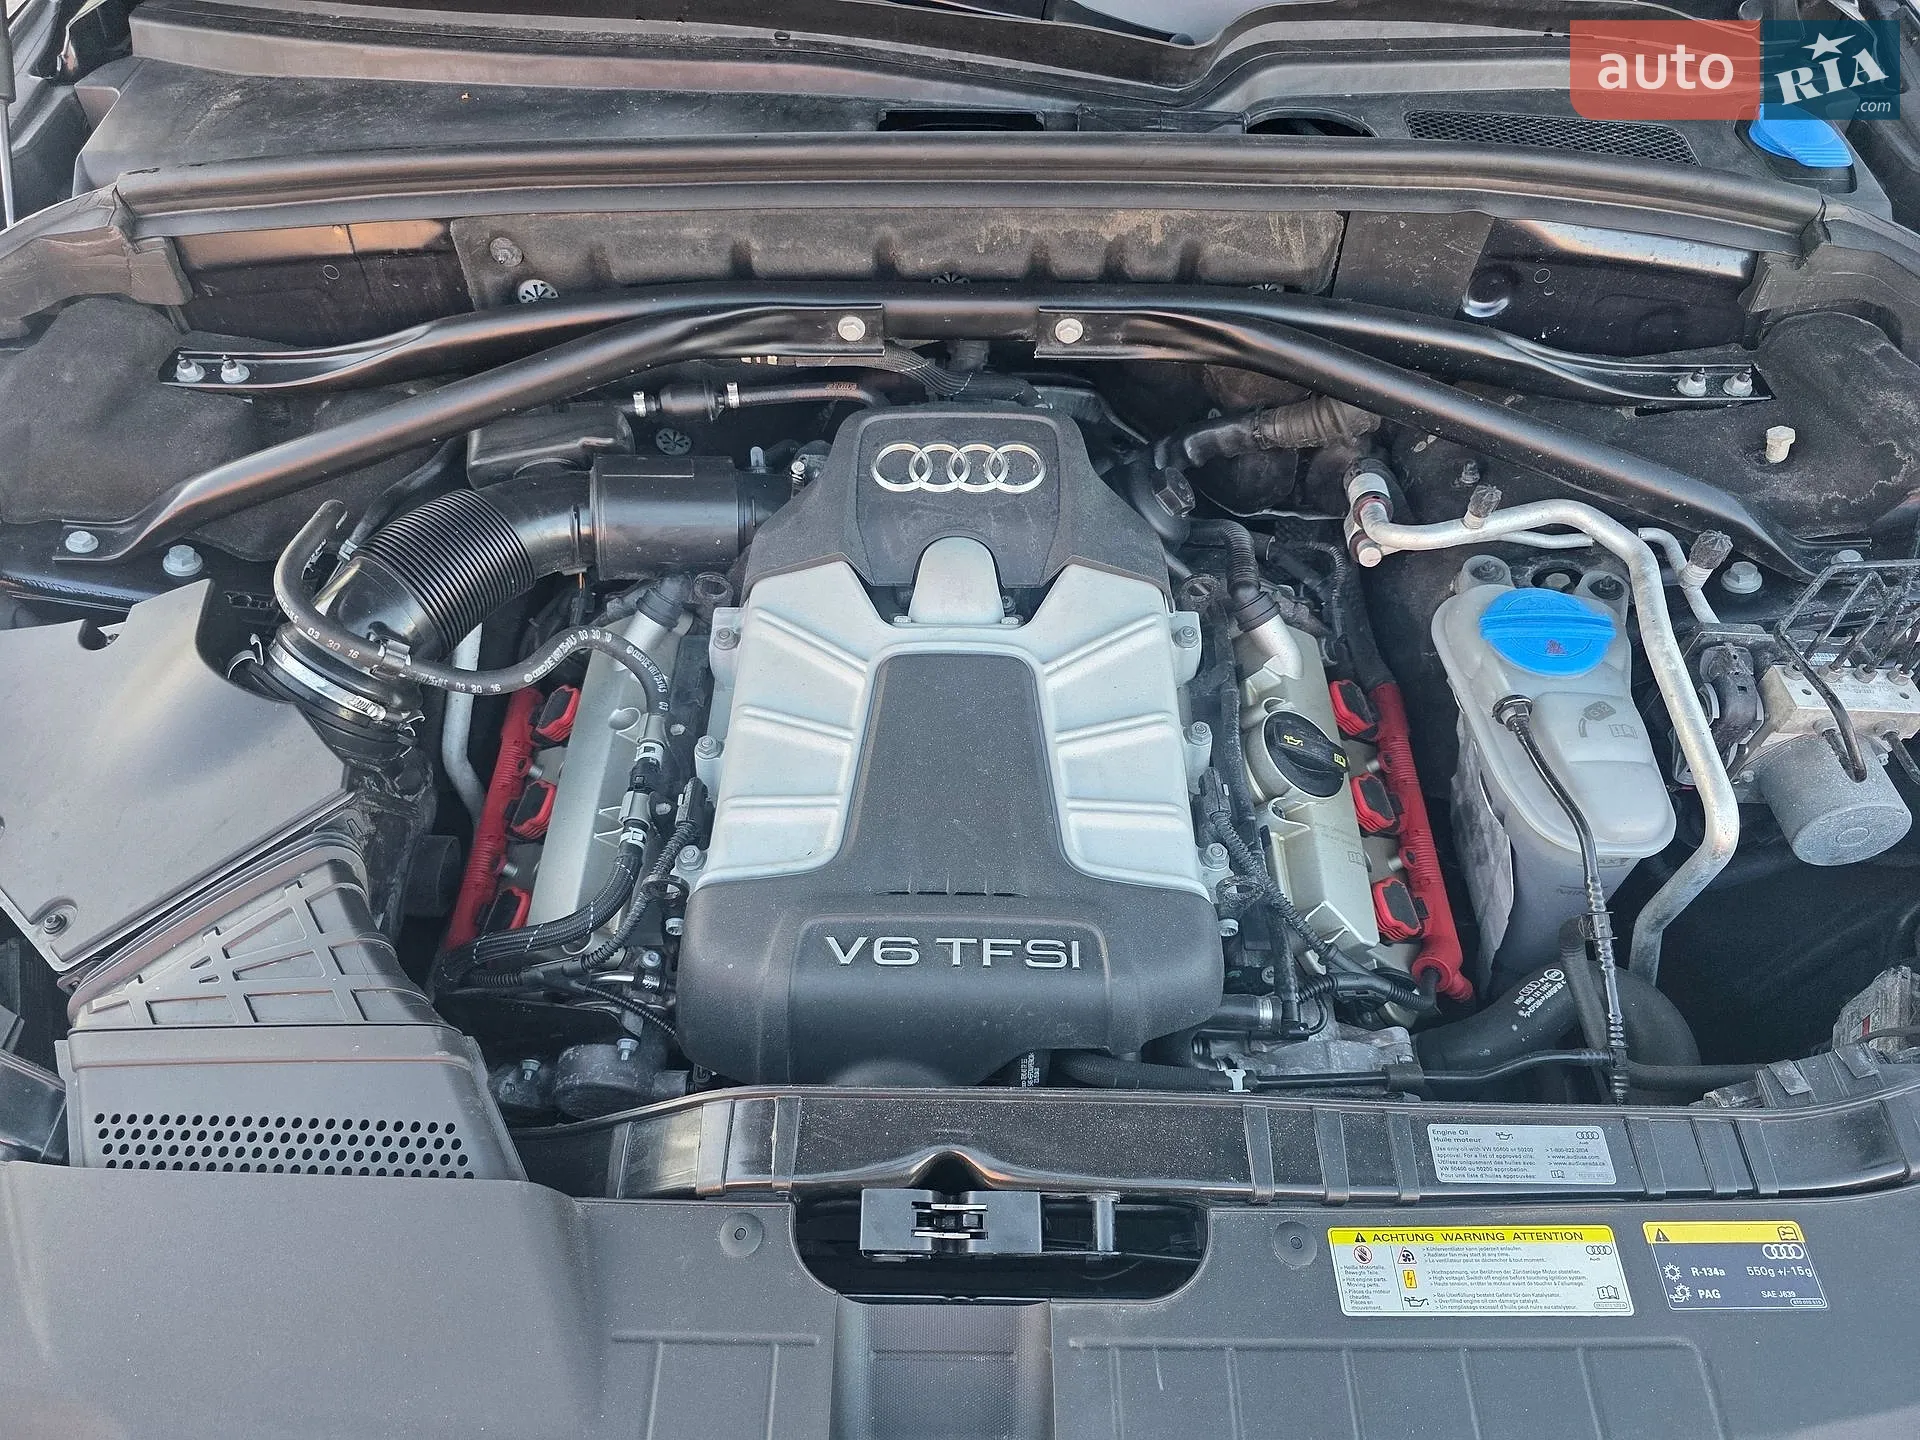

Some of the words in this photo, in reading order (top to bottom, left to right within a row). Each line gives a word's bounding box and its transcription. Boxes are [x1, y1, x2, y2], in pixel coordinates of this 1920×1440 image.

[307, 627, 321, 640] 03
[327, 639, 341, 651] 30
[347, 648, 360, 659] 16
[470, 684, 482, 693] 30
[490, 683, 502, 692] 16
[825, 936, 920, 966] V6
[936, 938, 1081, 970] TFSI
[1372, 1232, 1434, 1242] ACHTUNG
[1441, 1232, 1505, 1241] WARNING
[1512, 1231, 1583, 1241] ATTENTION
[1691, 1266, 1726, 1277] R-134a
[1746, 1266, 1775, 1278] 550g
[1698, 1289, 1721, 1299] PAG
[1761, 1290, 1778, 1298] SAE
[1778, 1290, 1796, 1298] J639
